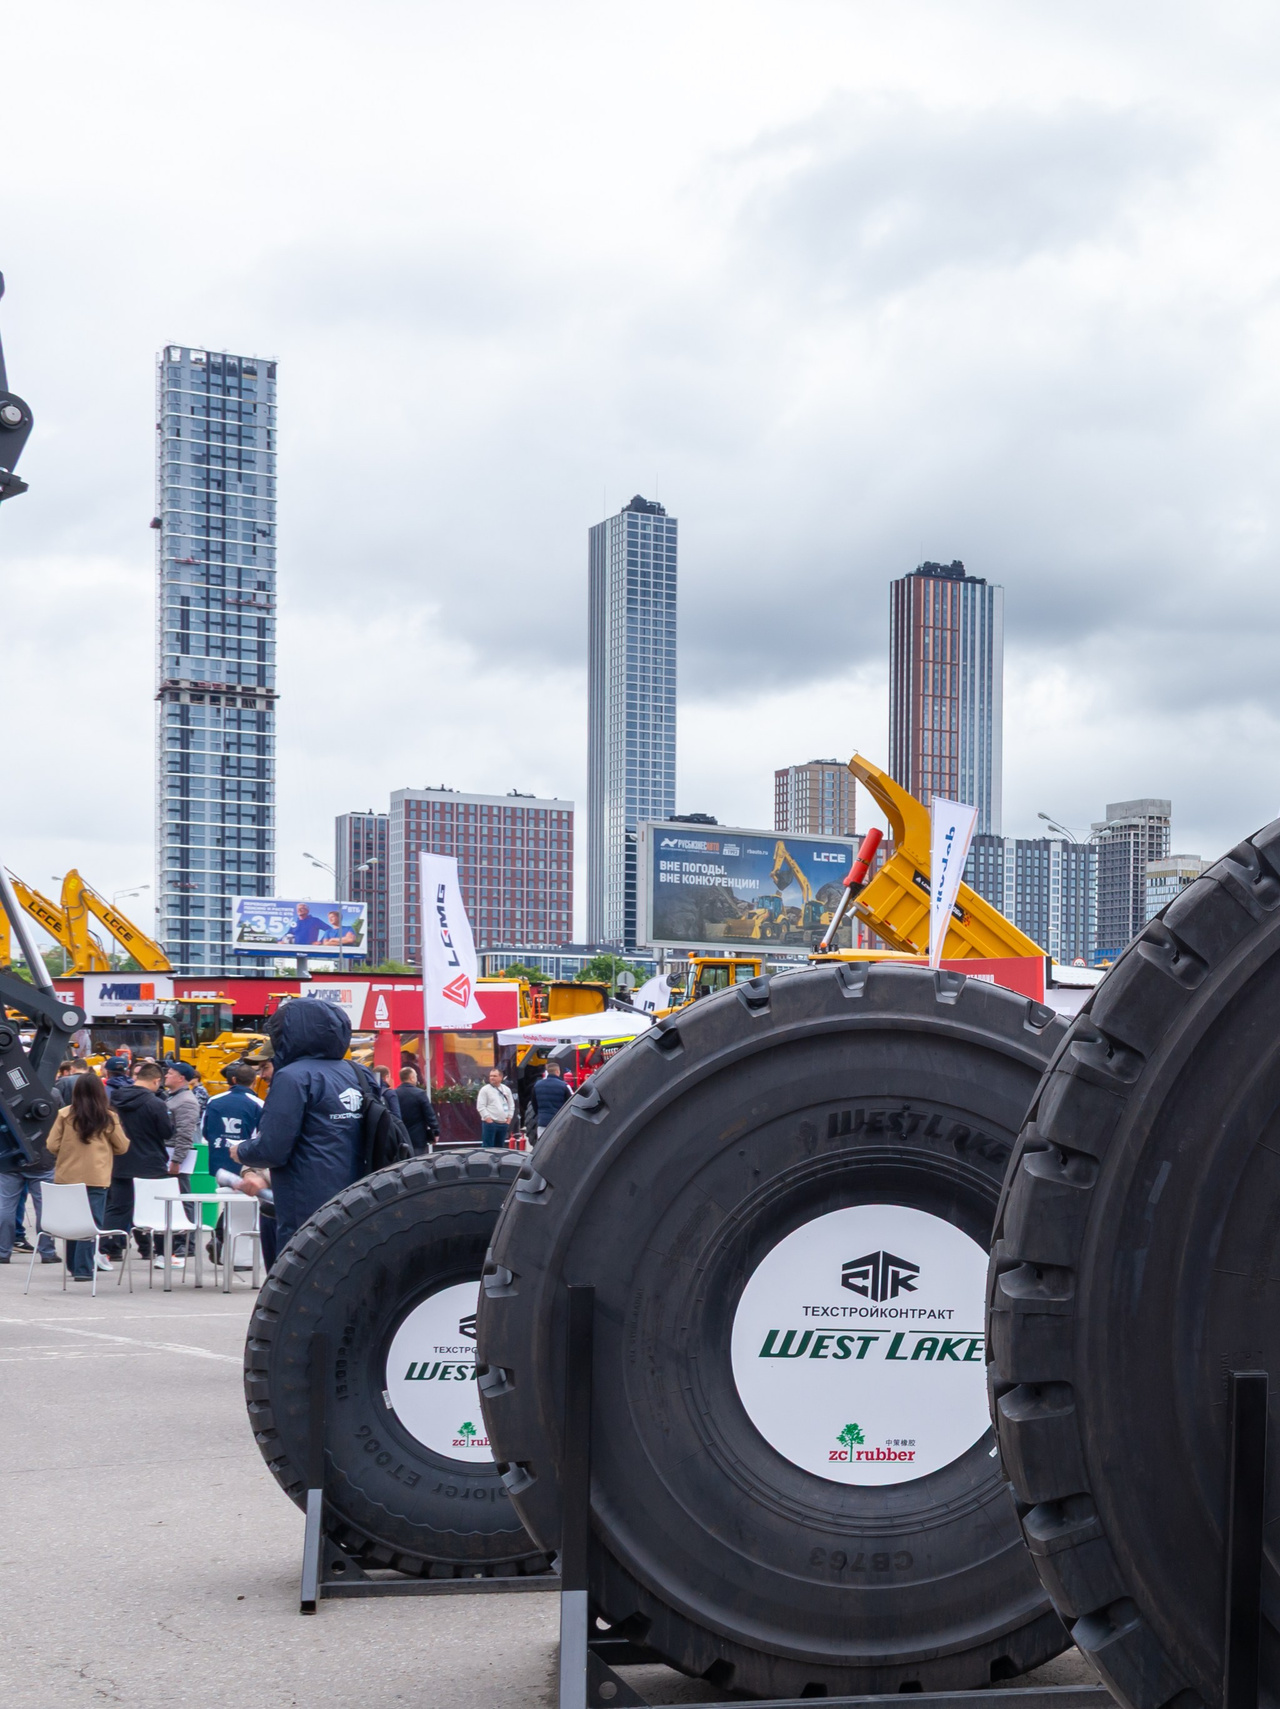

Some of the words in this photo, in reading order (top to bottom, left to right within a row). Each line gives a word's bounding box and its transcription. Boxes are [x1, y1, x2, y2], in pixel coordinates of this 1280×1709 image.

[660, 860, 680, 871] ВНЕ
[682, 862, 728, 876] ПОГОДЫ.
[660, 872, 680, 884] ВНЕ
[682, 874, 760, 890] КОНКУРЕНЦИИ!
[802, 1305, 955, 1320] ТЕХСТРОЙКОНТРАКТ
[758, 1329, 880, 1360] WEST
[885, 1332, 985, 1361] LAKE
[452, 1438, 466, 1446] zc
[829, 1450, 848, 1461] zc
[856, 1448, 915, 1462] rubber
[808, 1547, 914, 1573] CB763
